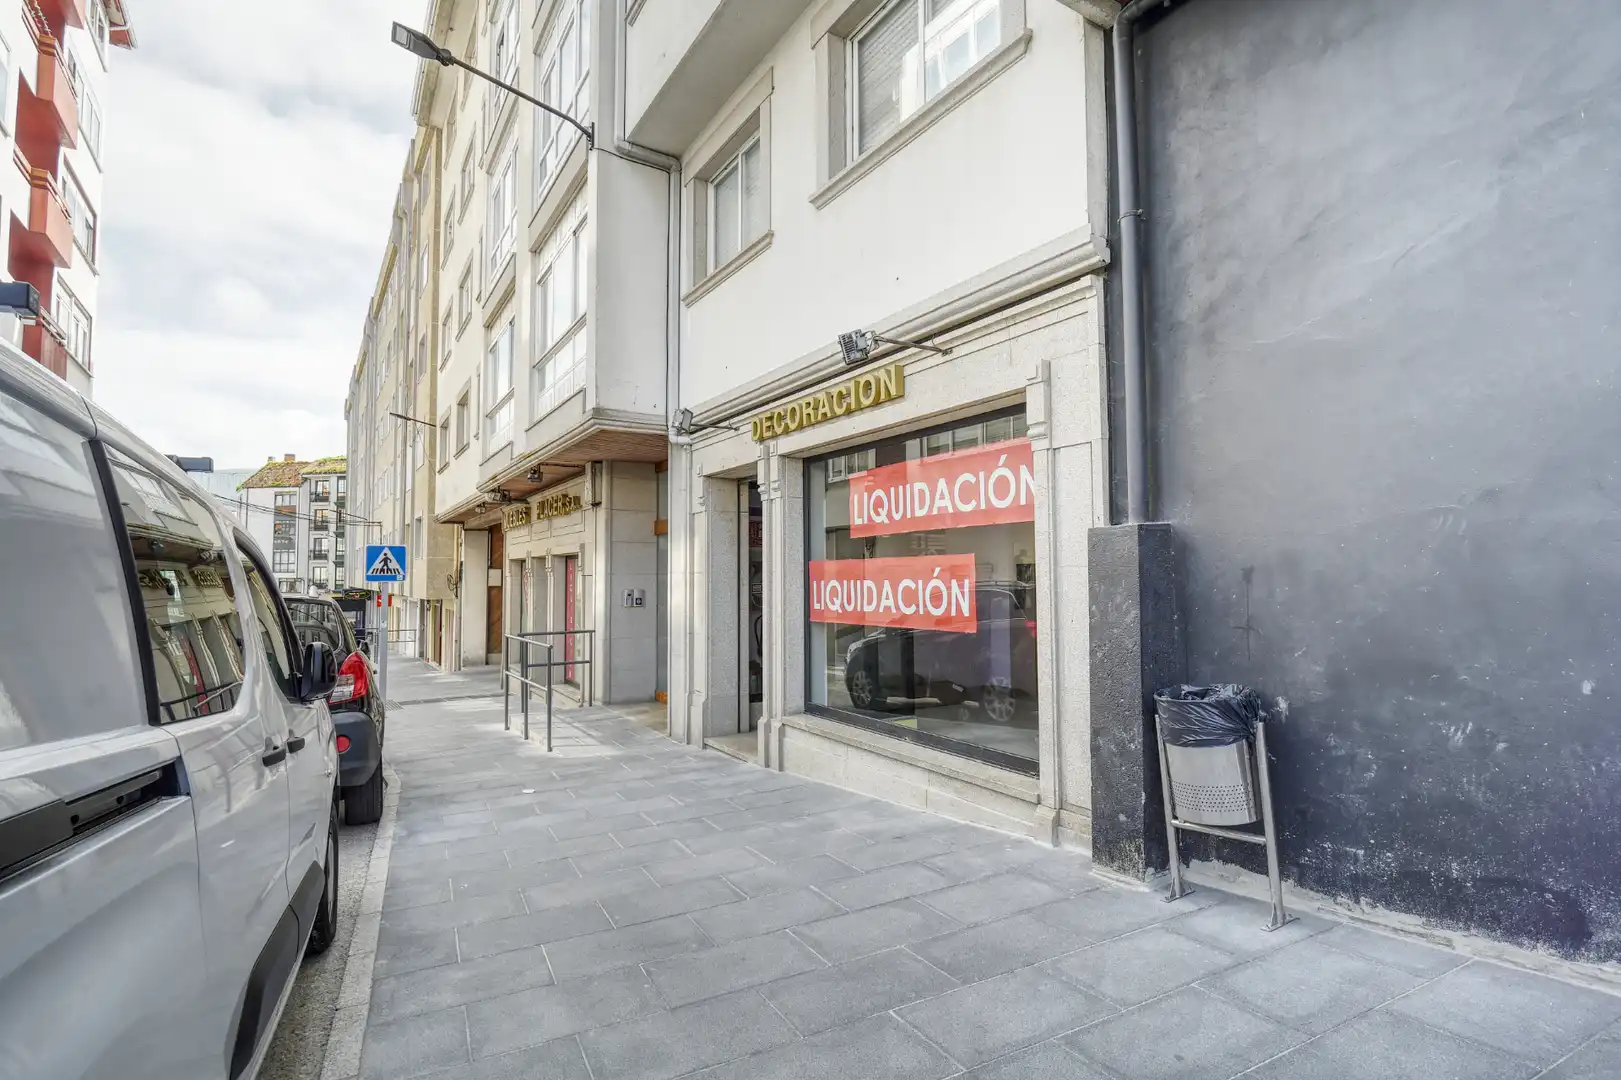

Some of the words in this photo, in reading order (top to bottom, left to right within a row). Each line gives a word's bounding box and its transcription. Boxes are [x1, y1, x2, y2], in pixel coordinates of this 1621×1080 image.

[751, 365, 904, 441] DECORACION
[853, 454, 1036, 525] LIQUIDACIÓN
[813, 567, 970, 617] LIQUIDACIÓN
